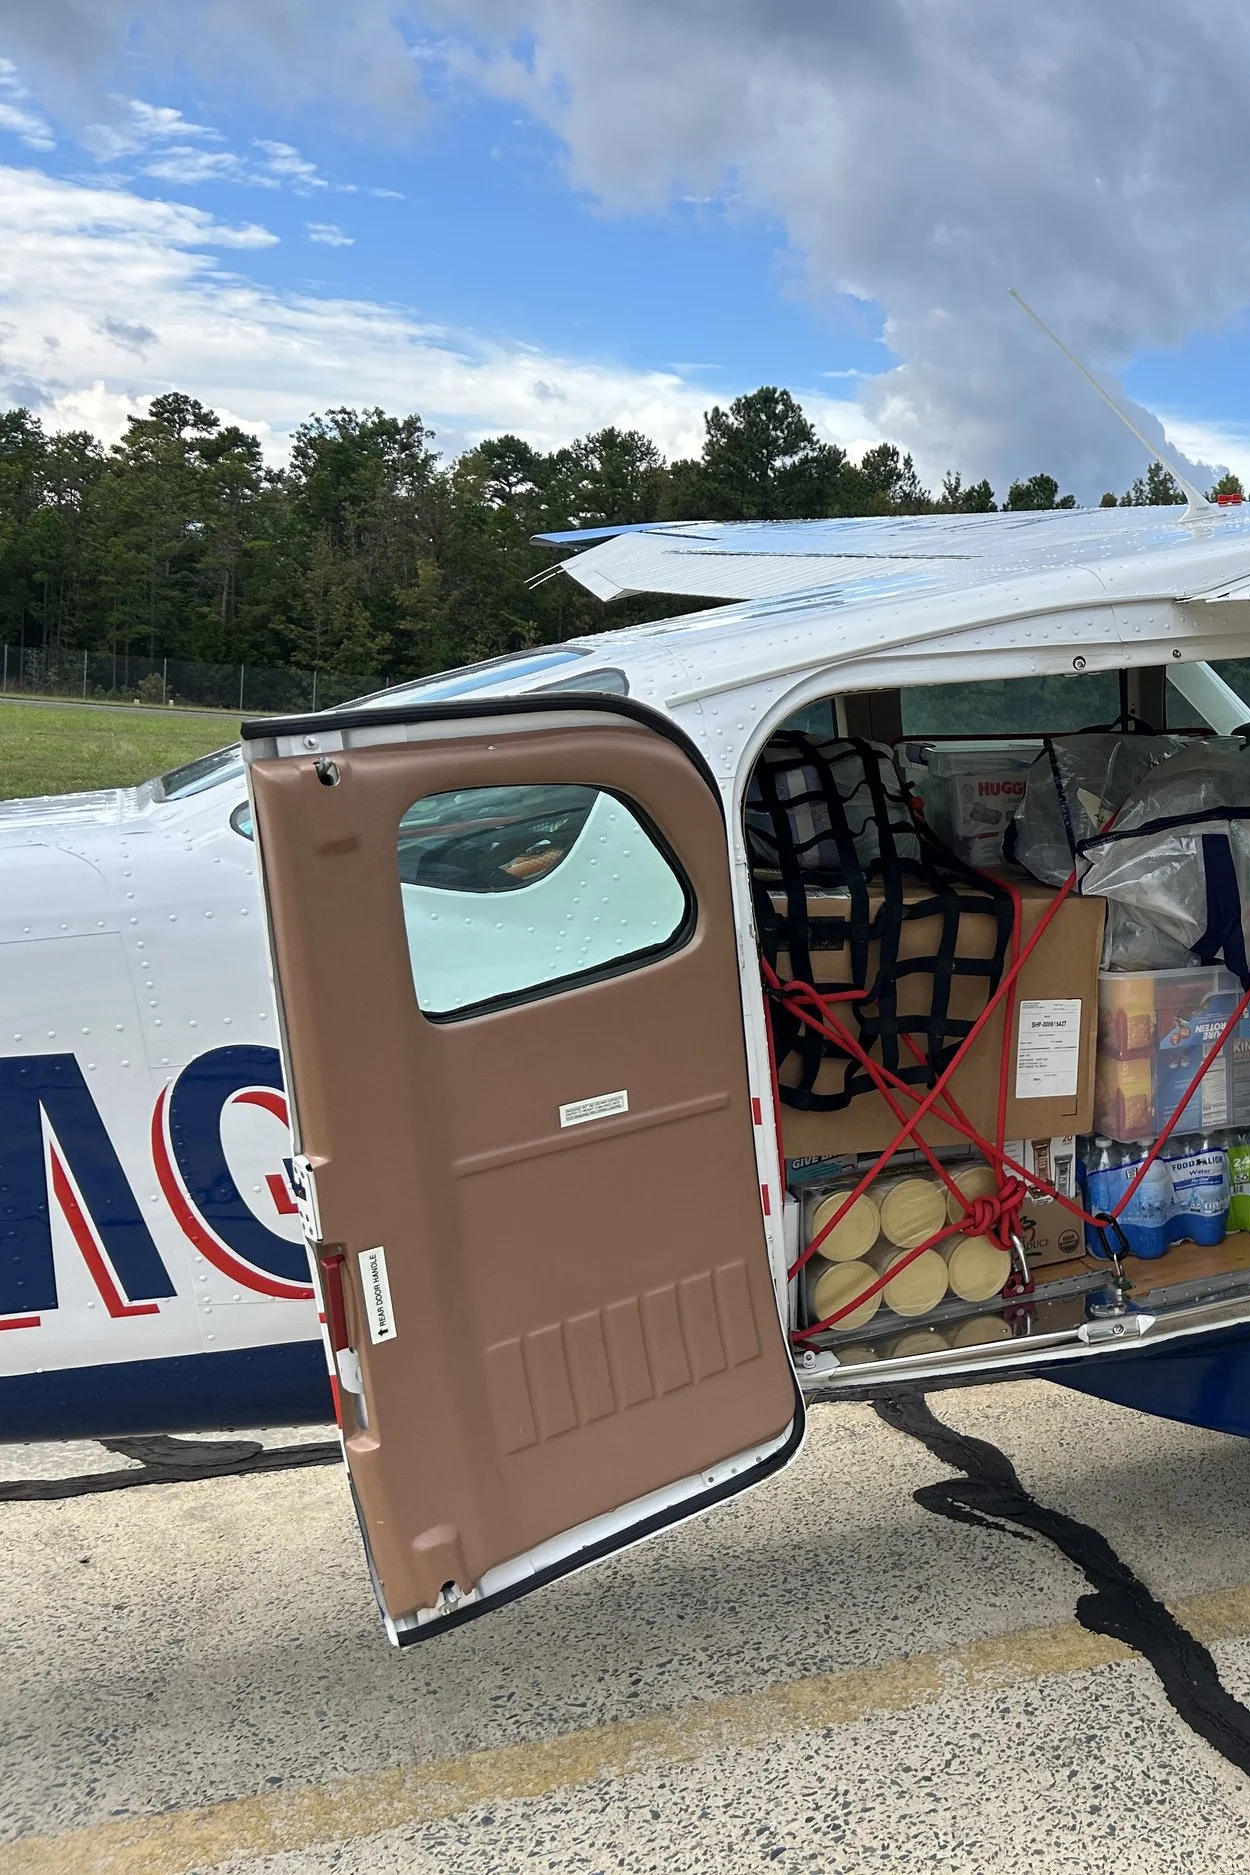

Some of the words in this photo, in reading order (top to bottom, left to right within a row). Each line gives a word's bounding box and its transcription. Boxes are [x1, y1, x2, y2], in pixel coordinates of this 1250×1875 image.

[1202, 1030, 1223, 1040] URE
[792, 1156, 819, 1169] GIVE
[1171, 1160, 1195, 1171] FOOD
[1233, 1156, 1250, 1167] 24
[1189, 1168, 1211, 1176] Water
[369, 1253, 380, 1284] HANDLE
[374, 1283, 384, 1306] DOOR
[377, 1307, 386, 1327] REAR
